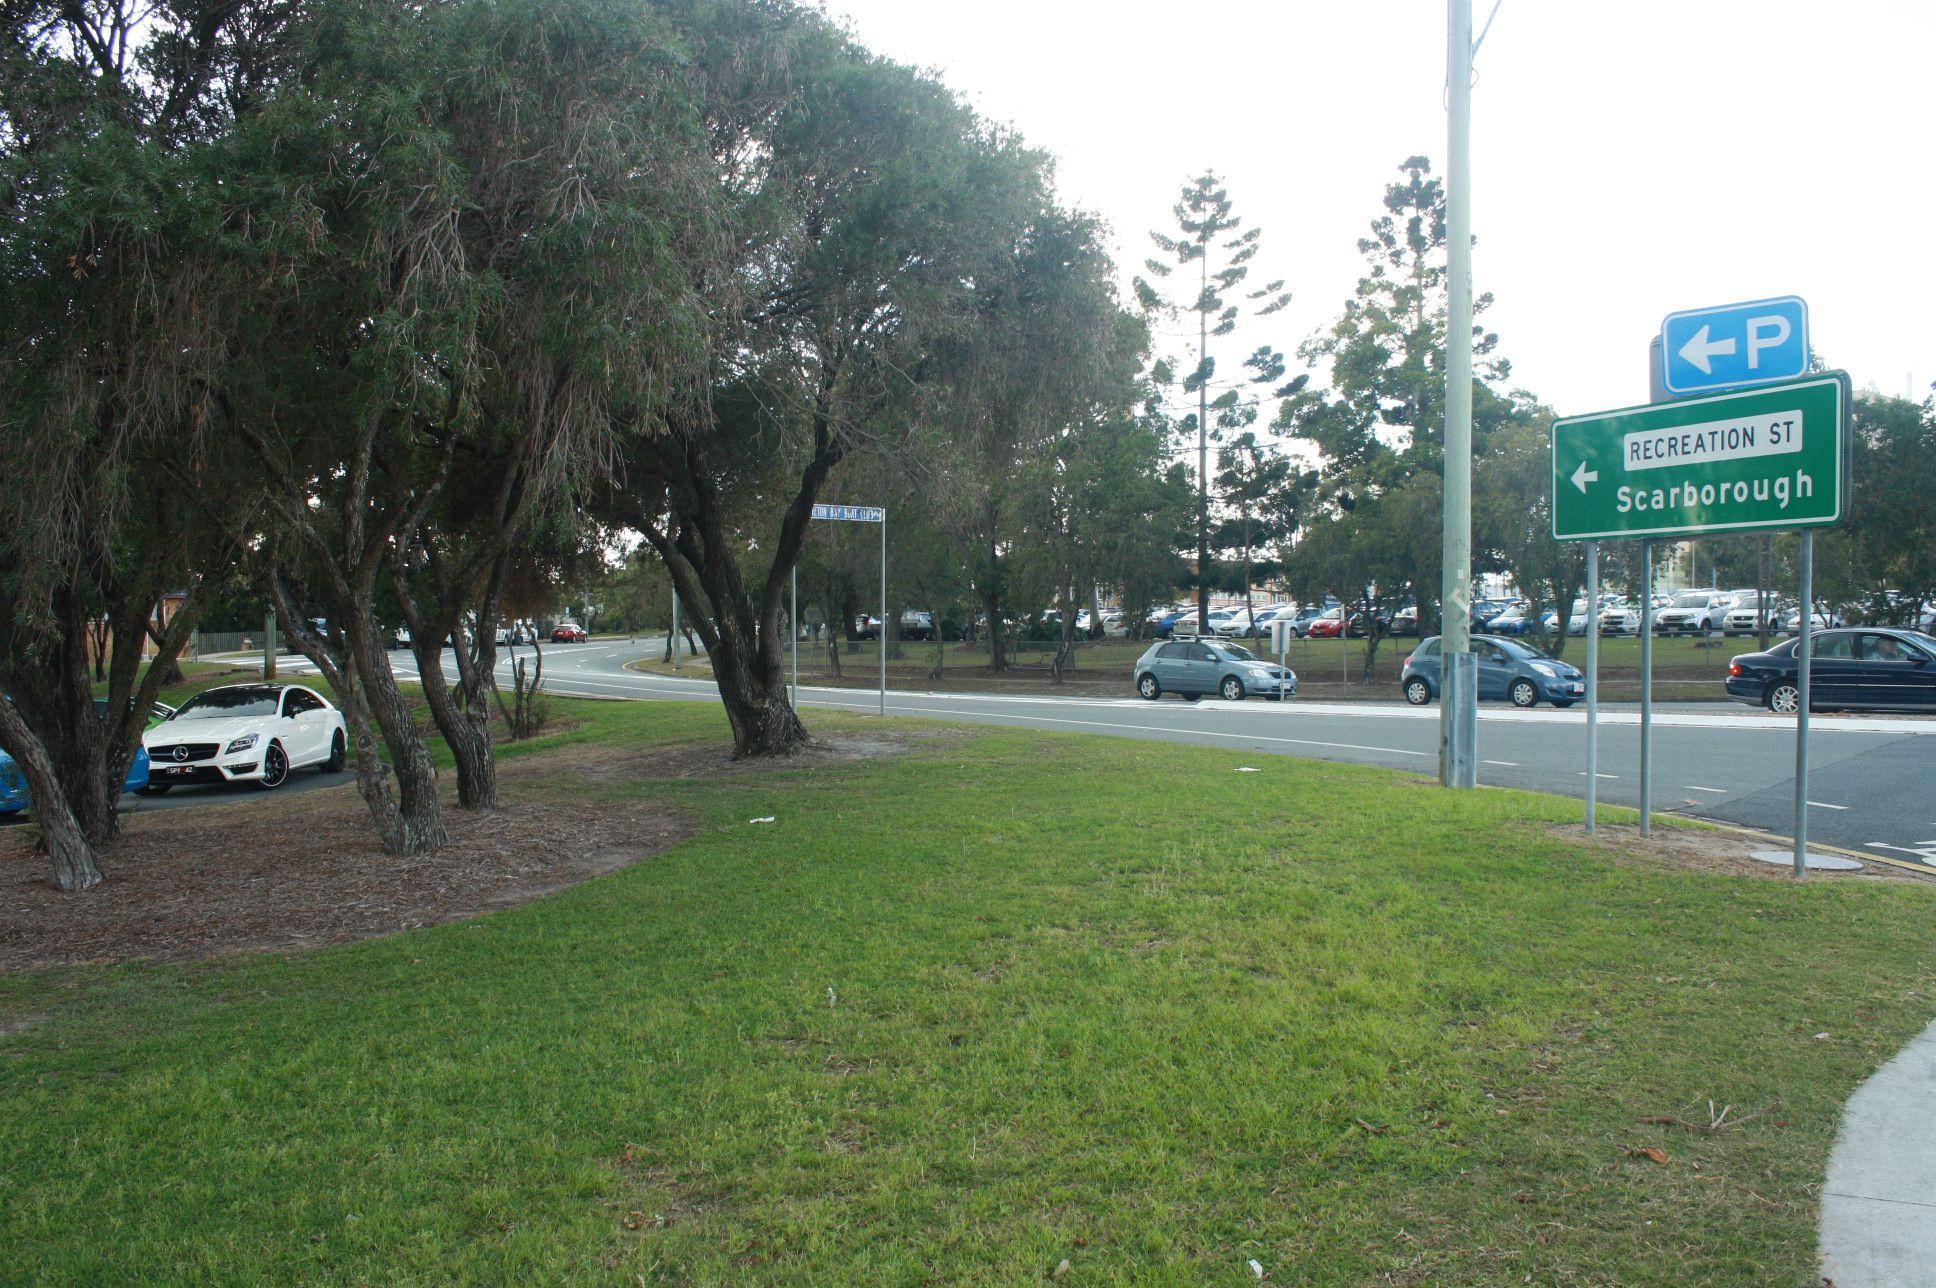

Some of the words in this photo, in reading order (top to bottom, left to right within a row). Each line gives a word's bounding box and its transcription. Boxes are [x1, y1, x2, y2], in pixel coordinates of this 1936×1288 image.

[1746, 315, 1791, 369] P
[1630, 426, 1755, 462] RECREATION
[1769, 421, 1794, 445] ST
[1616, 469, 1812, 512] Scarborough
